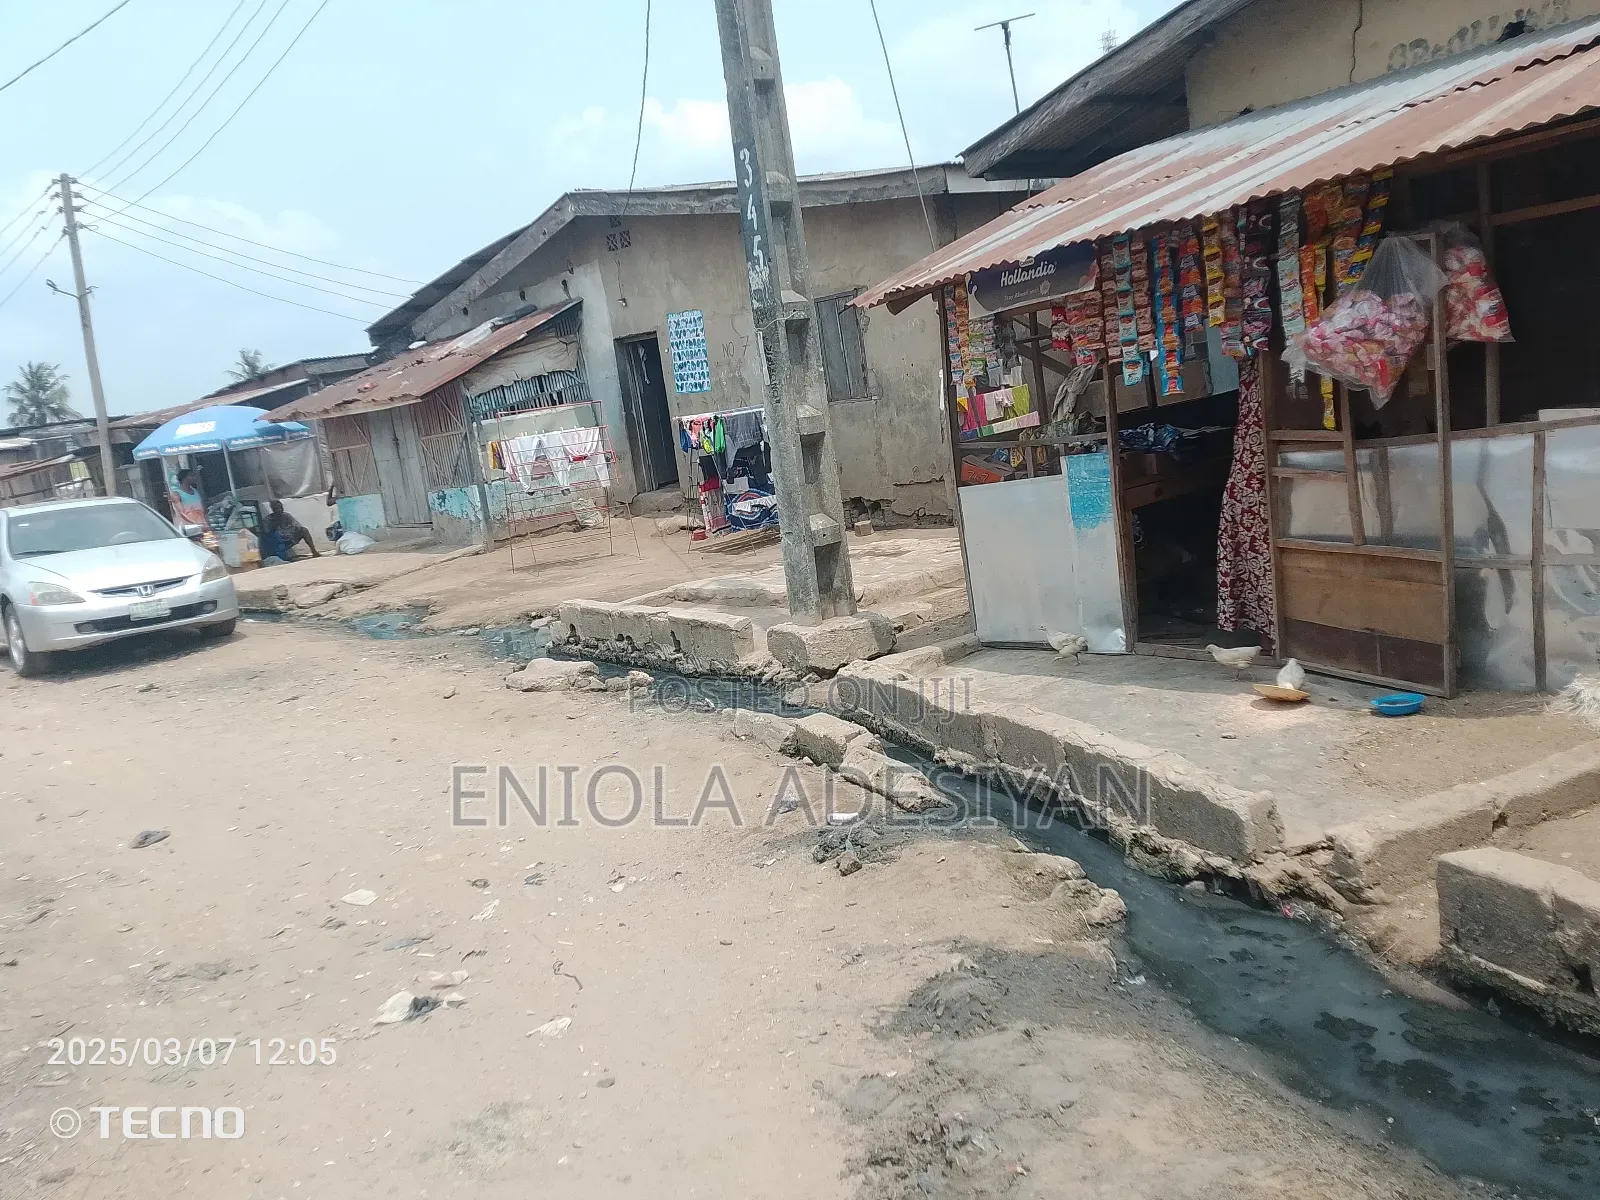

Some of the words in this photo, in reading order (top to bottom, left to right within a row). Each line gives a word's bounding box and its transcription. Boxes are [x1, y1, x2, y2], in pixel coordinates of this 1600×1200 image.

[1000, 261, 1056, 287] Hollandia
[721, 341, 735, 358] NO
[740, 336, 750, 356] 7
